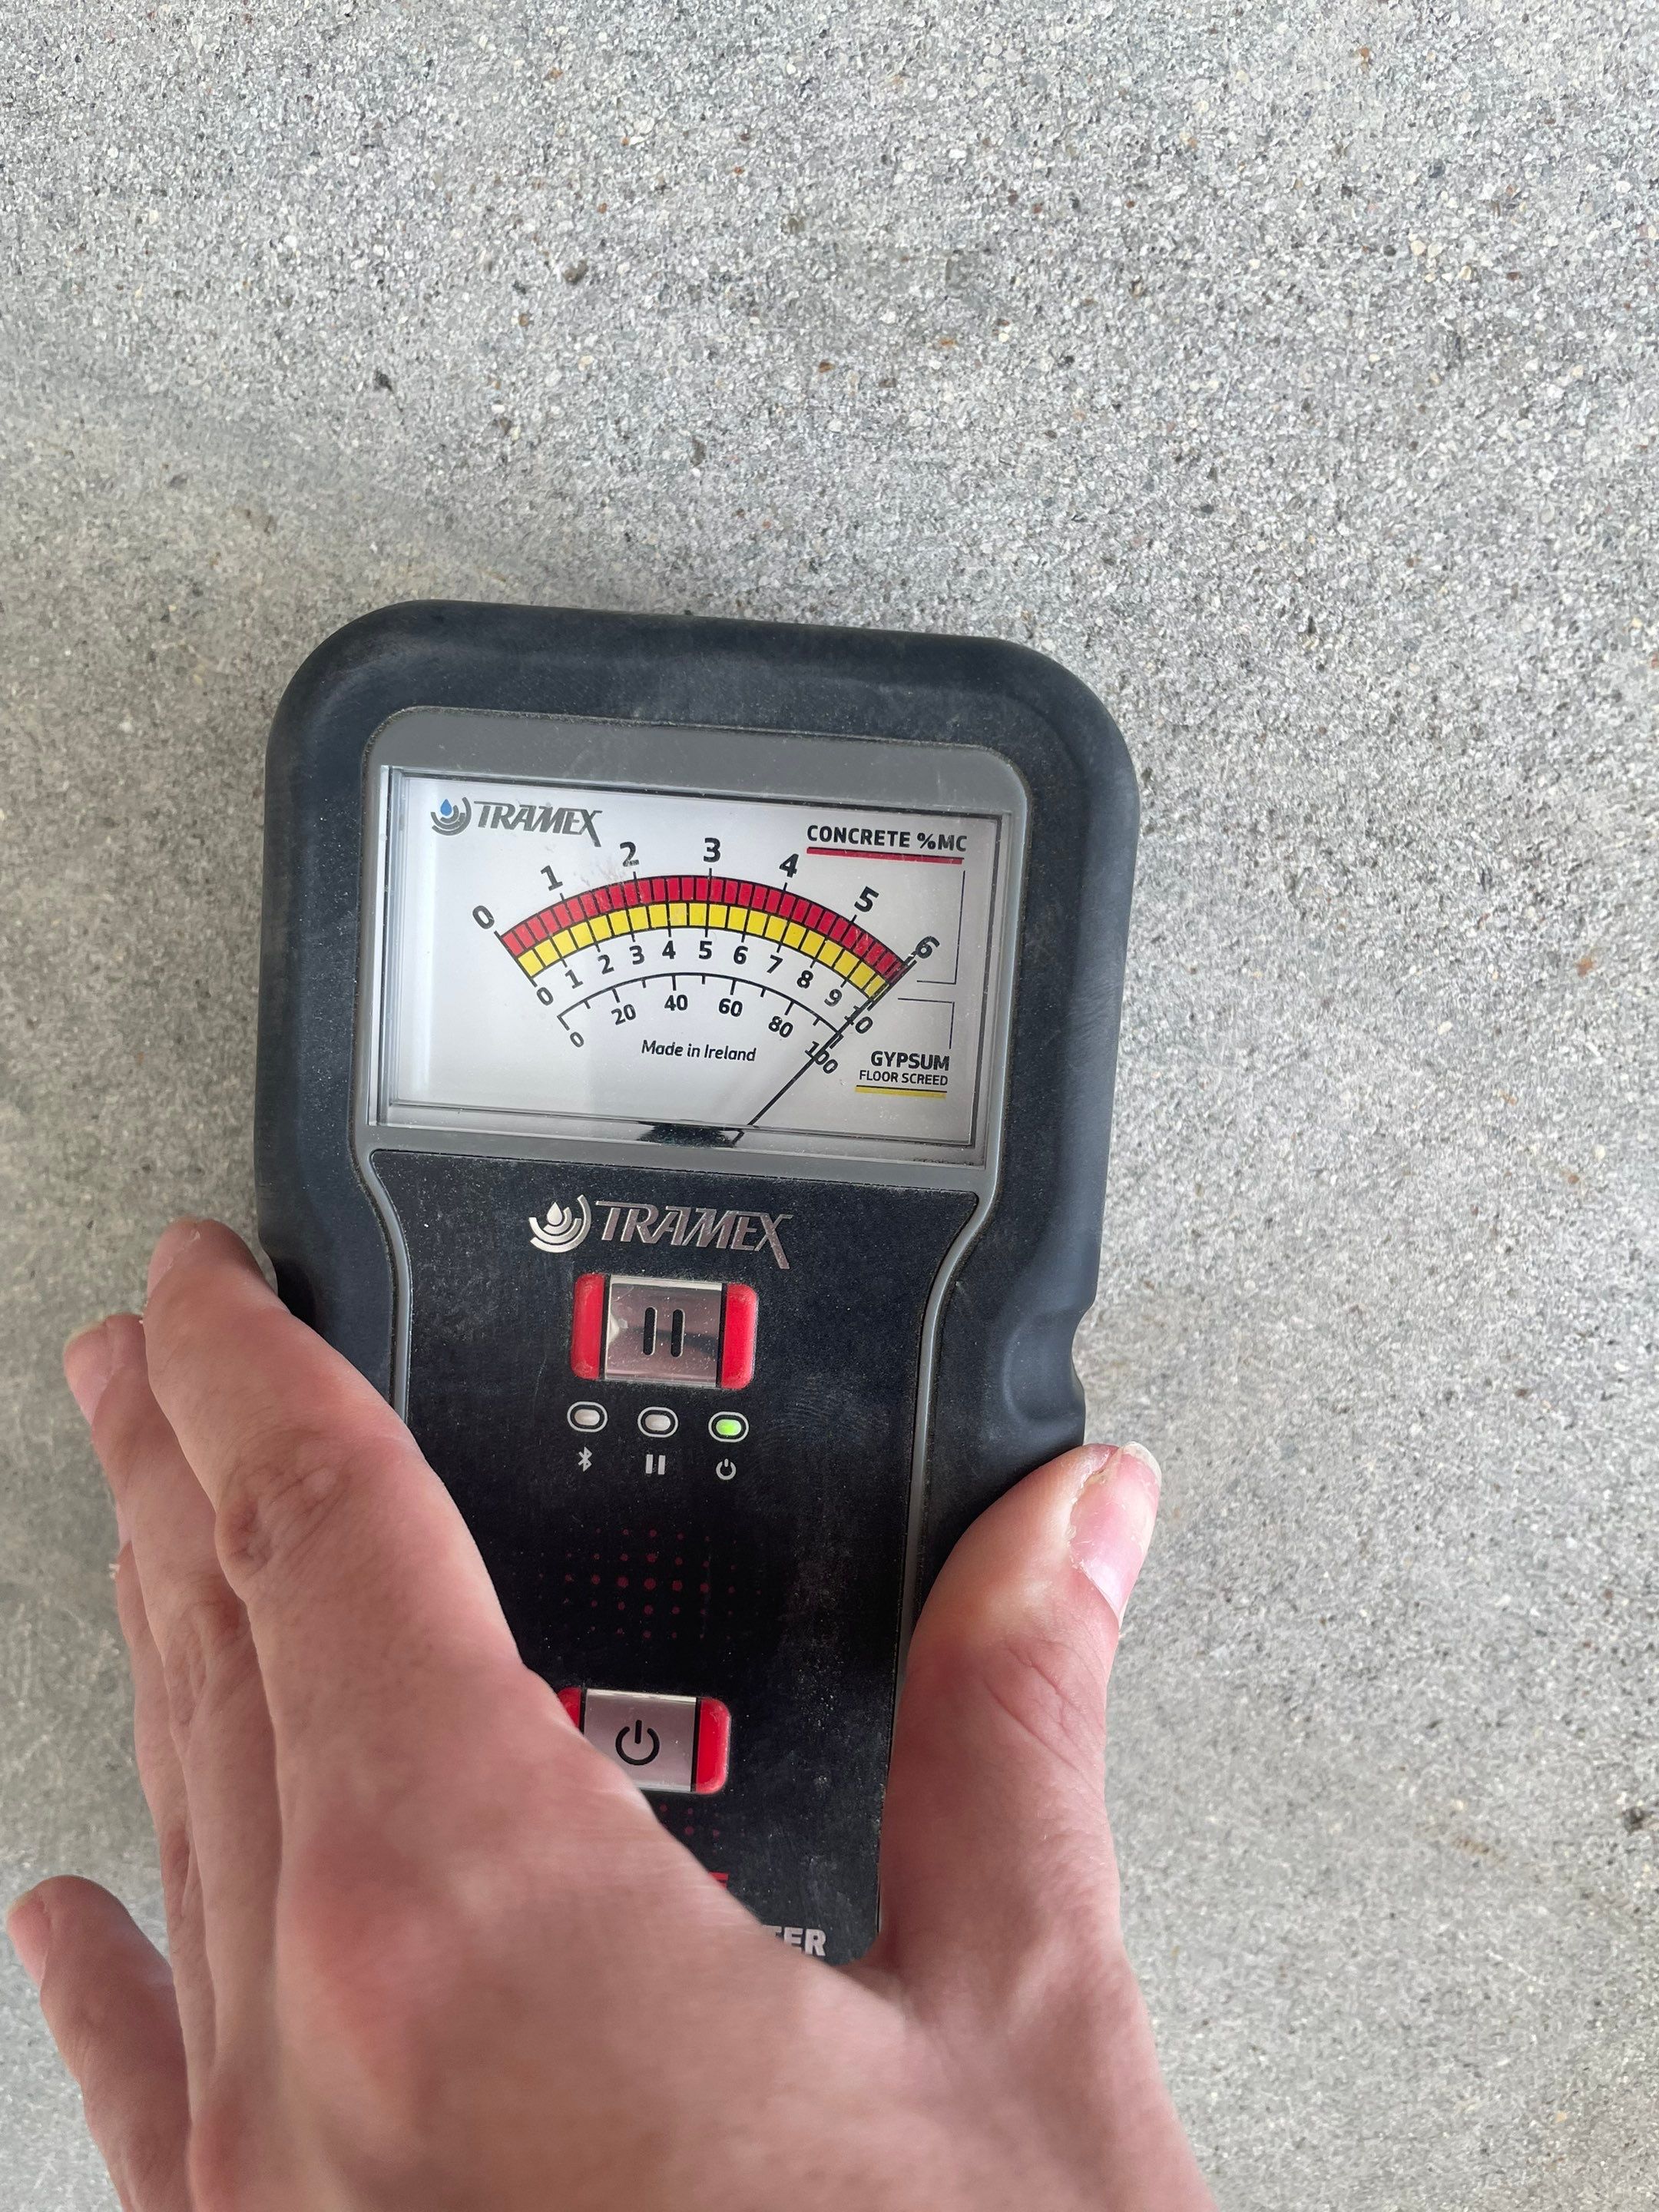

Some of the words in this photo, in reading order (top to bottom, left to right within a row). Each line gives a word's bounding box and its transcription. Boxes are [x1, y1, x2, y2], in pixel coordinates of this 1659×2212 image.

[473, 800, 604, 848] TRAMEX
[806, 824, 911, 848] CONCRETE
[916, 832, 968, 853] %MC
[472, 905, 495, 930] 0
[540, 865, 564, 892] 1
[619, 841, 640, 867] 2
[703, 837, 721, 863] 3
[779, 853, 799, 878] 4
[853, 886, 879, 913] 5
[916, 935, 940, 959] 6
[535, 986, 555, 1006] 0
[565, 969, 584, 989] 1
[598, 954, 615, 975] 2
[628, 945, 645, 965] 3
[661, 940, 677, 960] 4
[698, 940, 713, 960] 5
[733, 945, 749, 965] 6
[767, 954, 783, 974] 7
[796, 969, 814, 989] 8
[823, 988, 843, 1007] 9
[569, 1031, 584, 1048] 0
[611, 1003, 637, 1026] 20
[664, 994, 688, 1012] 40
[718, 998, 743, 1018] 60
[768, 1015, 794, 1038] 80
[804, 1040, 839, 1075] 100
[641, 1039, 684, 1057] Made
[687, 1043, 700, 1058] in
[704, 1044, 757, 1062] Ireland
[859, 1069, 899, 1083] FLOOR
[901, 1072, 949, 1086] SCREED
[870, 1050, 950, 1071] GYPSUM
[594, 1200, 794, 1270] TRAMEX
